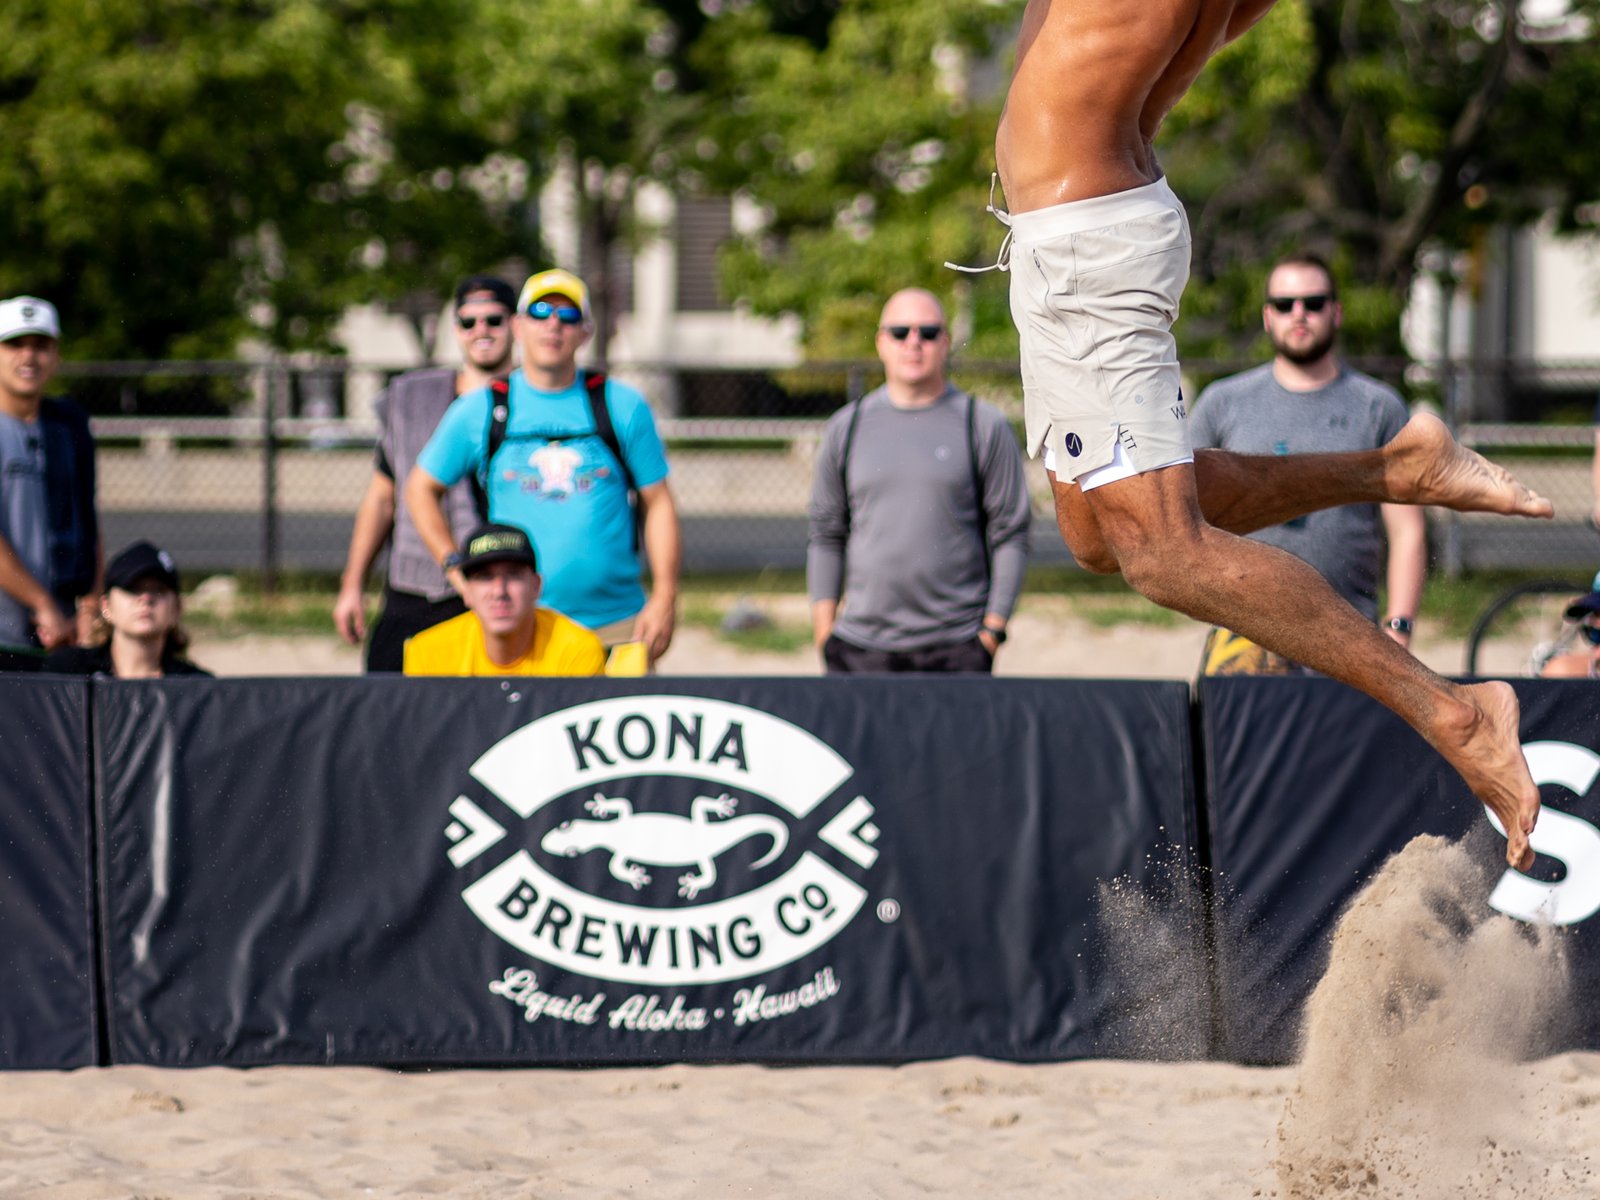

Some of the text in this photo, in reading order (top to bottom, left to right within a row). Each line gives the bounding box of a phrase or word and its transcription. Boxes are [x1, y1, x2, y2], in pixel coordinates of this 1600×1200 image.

[564, 710, 751, 773] KONA
[496, 879, 763, 969] BREWING
[488, 966, 842, 1031] Liquid Aloha Hawaii
